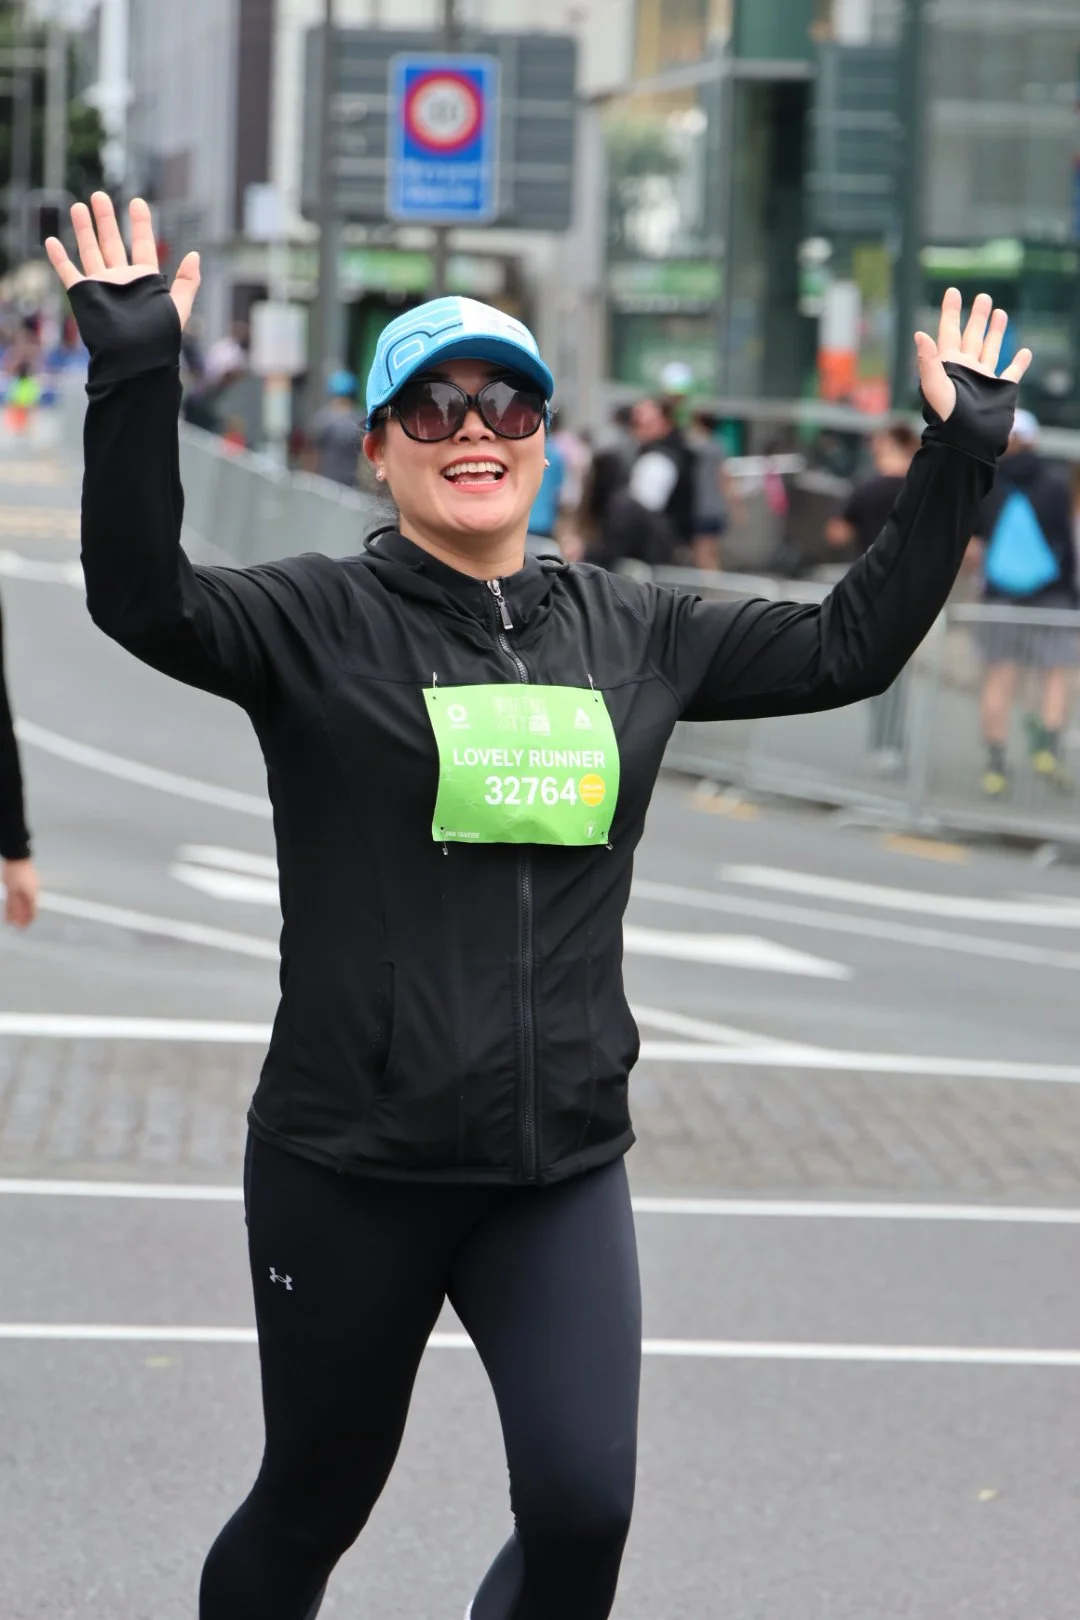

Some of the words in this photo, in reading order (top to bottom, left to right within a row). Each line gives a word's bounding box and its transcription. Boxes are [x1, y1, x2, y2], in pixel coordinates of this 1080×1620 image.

[453, 748, 524, 767] LOVELY
[529, 750, 606, 768] RUNNER
[484, 775, 578, 806] 32764
